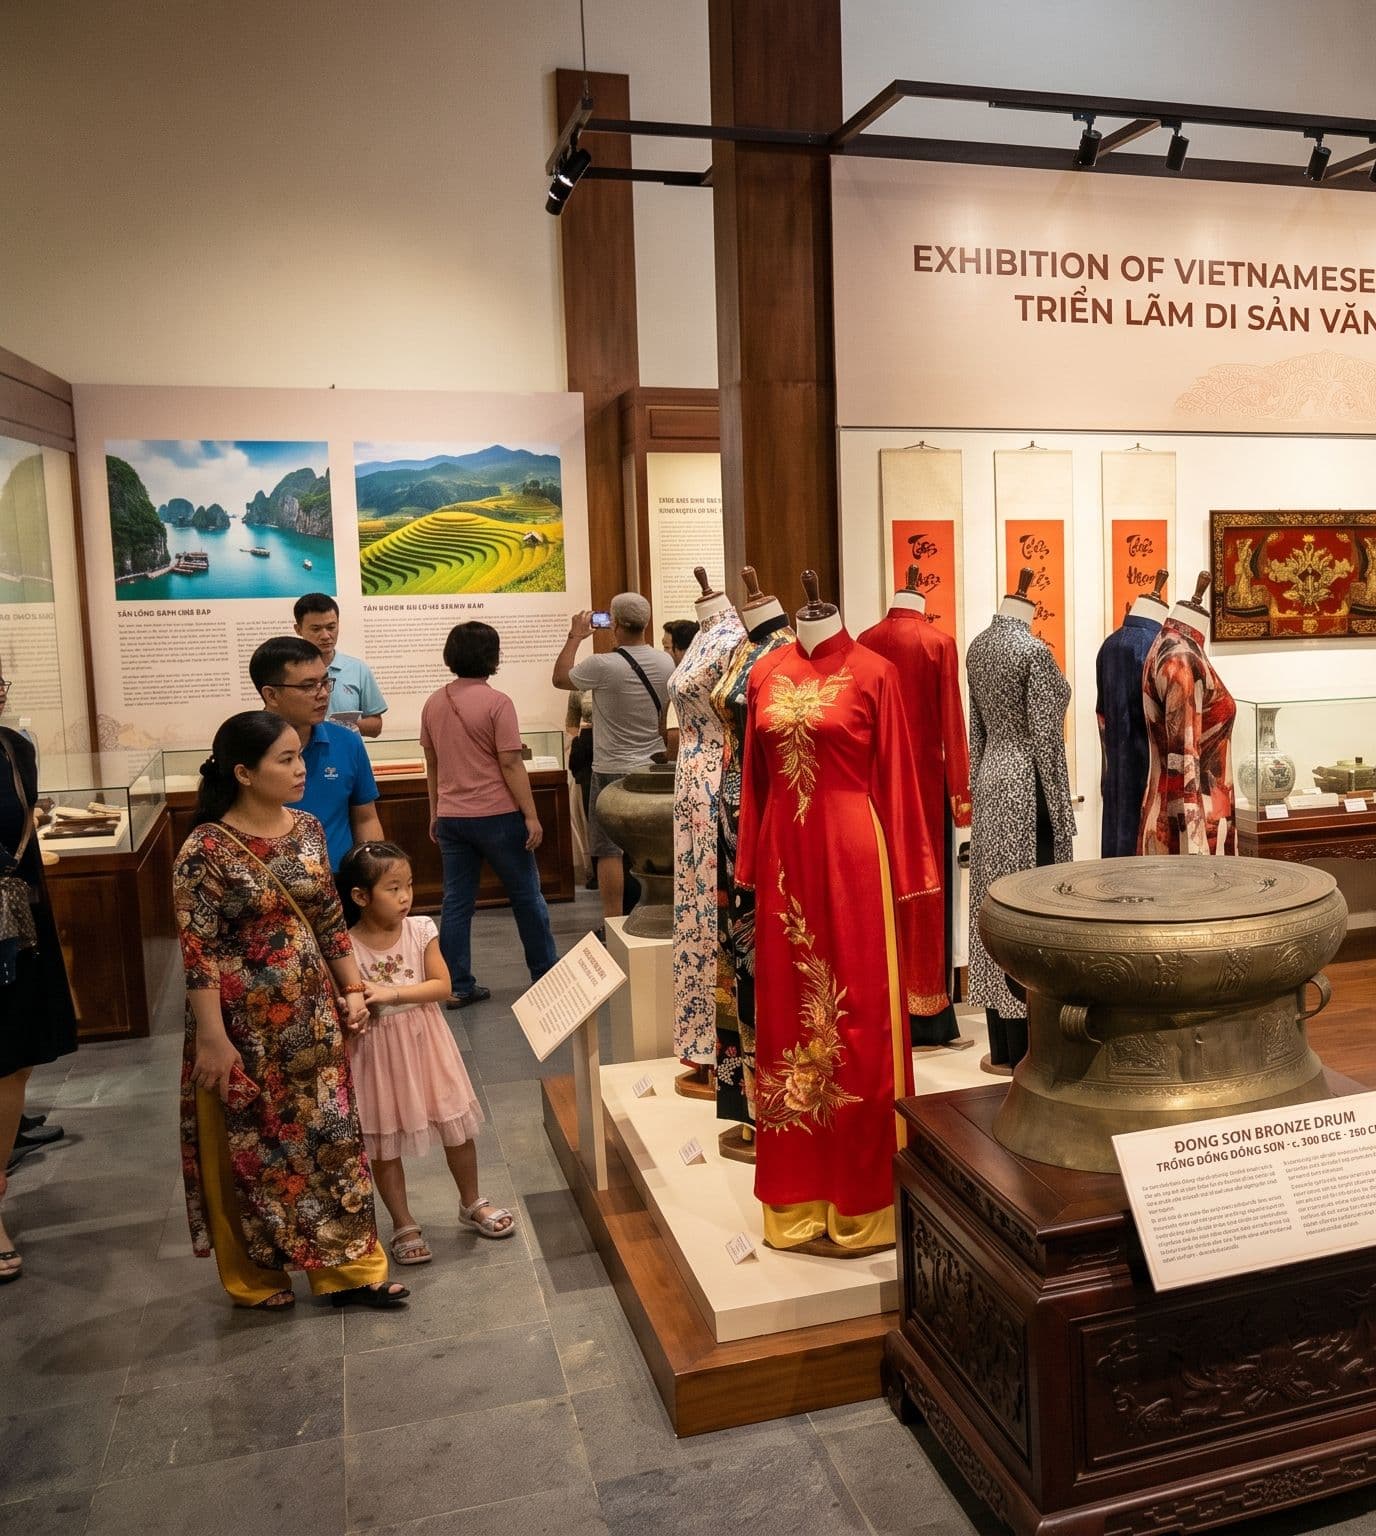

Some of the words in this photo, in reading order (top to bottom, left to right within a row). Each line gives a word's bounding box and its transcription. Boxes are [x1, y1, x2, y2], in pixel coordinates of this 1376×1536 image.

[913, 245, 1109, 281] EXHIBITION
[1120, 255, 1165, 283] OF
[1174, 258, 1376, 294] VIETNAMESE
[1014, 285, 1113, 325] TRIỂN
[1125, 293, 1194, 327] LÃM
[1205, 303, 1237, 330] DI
[1247, 296, 1310, 332] SẢN
[1254, 1118, 1312, 1140] BRONZE
[1314, 1110, 1356, 1129] DRUM
[1301, 1135, 1320, 1147] 300
[1321, 1131, 1342, 1143] BCE
